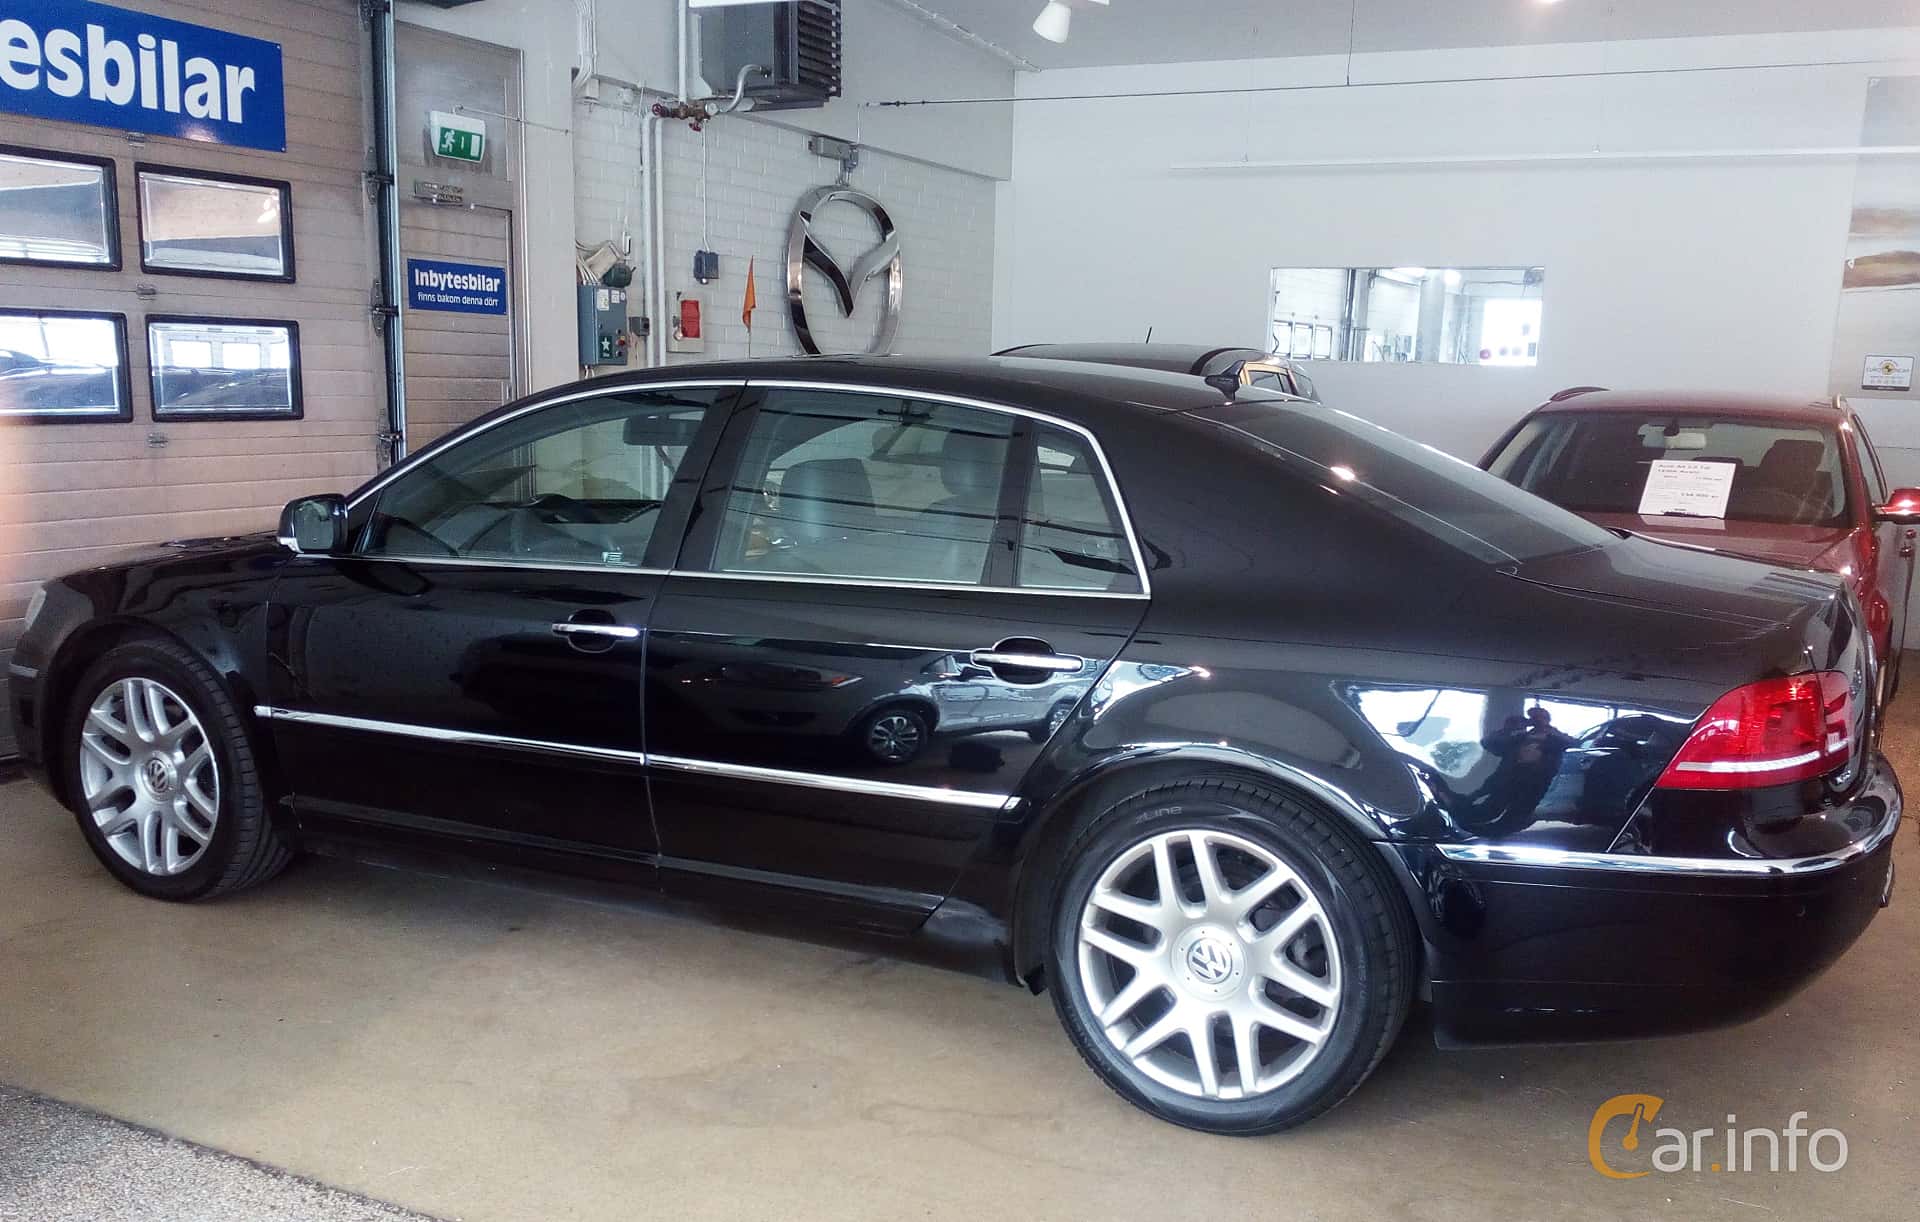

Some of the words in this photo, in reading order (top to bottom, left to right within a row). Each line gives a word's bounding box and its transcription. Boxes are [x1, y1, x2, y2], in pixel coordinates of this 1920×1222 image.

[0, 19, 256, 124] esbilar
[415, 268, 500, 292] Inbytesbilar
[418, 292, 436, 302] finns
[437, 294, 460, 304] bakom
[462, 296, 482, 305] denna
